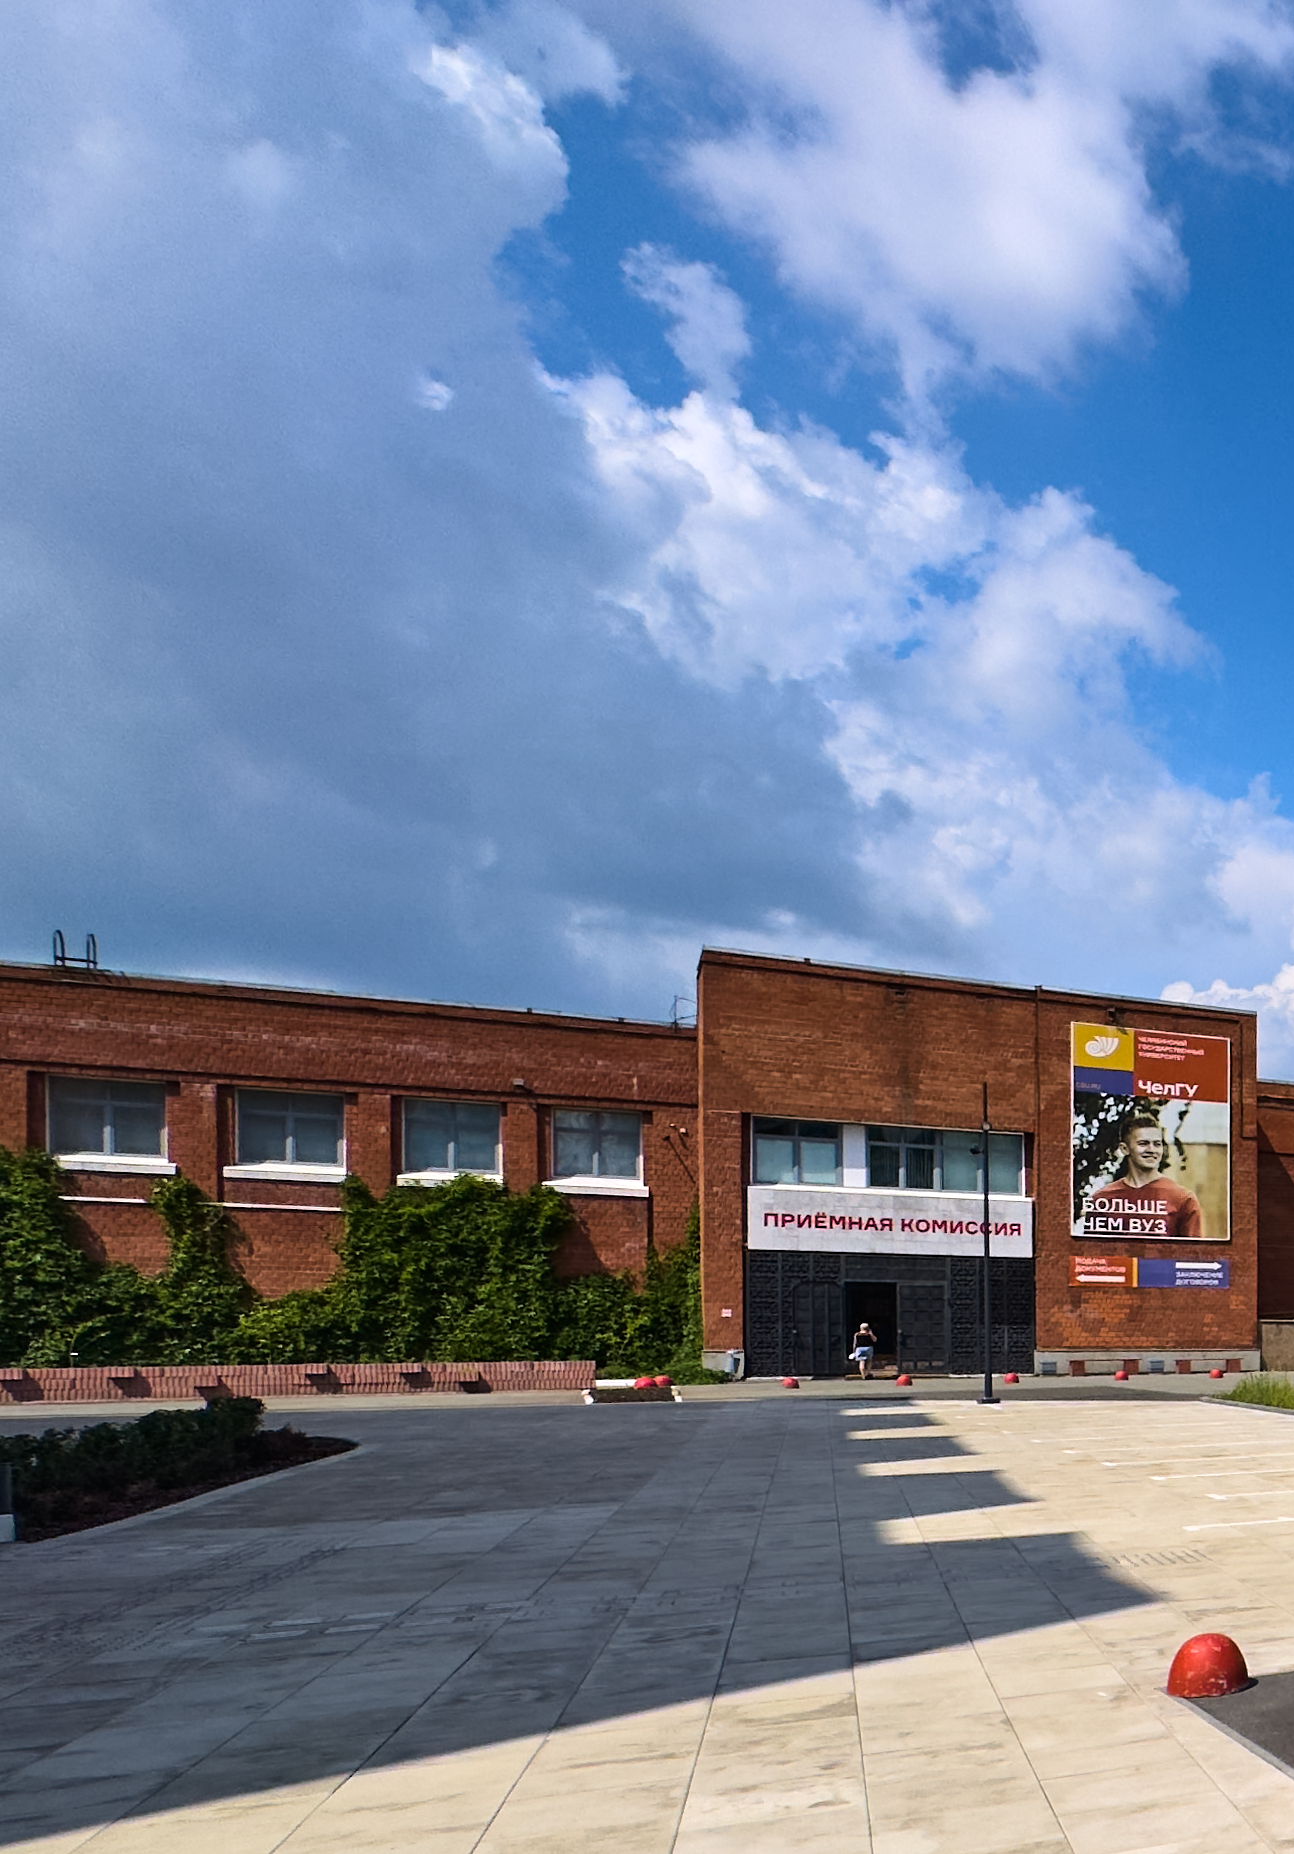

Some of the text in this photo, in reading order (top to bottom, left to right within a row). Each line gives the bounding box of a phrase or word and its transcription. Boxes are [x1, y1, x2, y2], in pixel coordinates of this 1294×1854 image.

[1138, 1079, 1199, 1098] ЧелГУ
[1082, 1197, 1168, 1213] БОЛЬШЕ
[763, 1211, 1022, 1236] ПРИЁМНАЯ КОМИССИЯ
[1084, 1216, 1167, 1233] ЧЕМ ВУЗ
